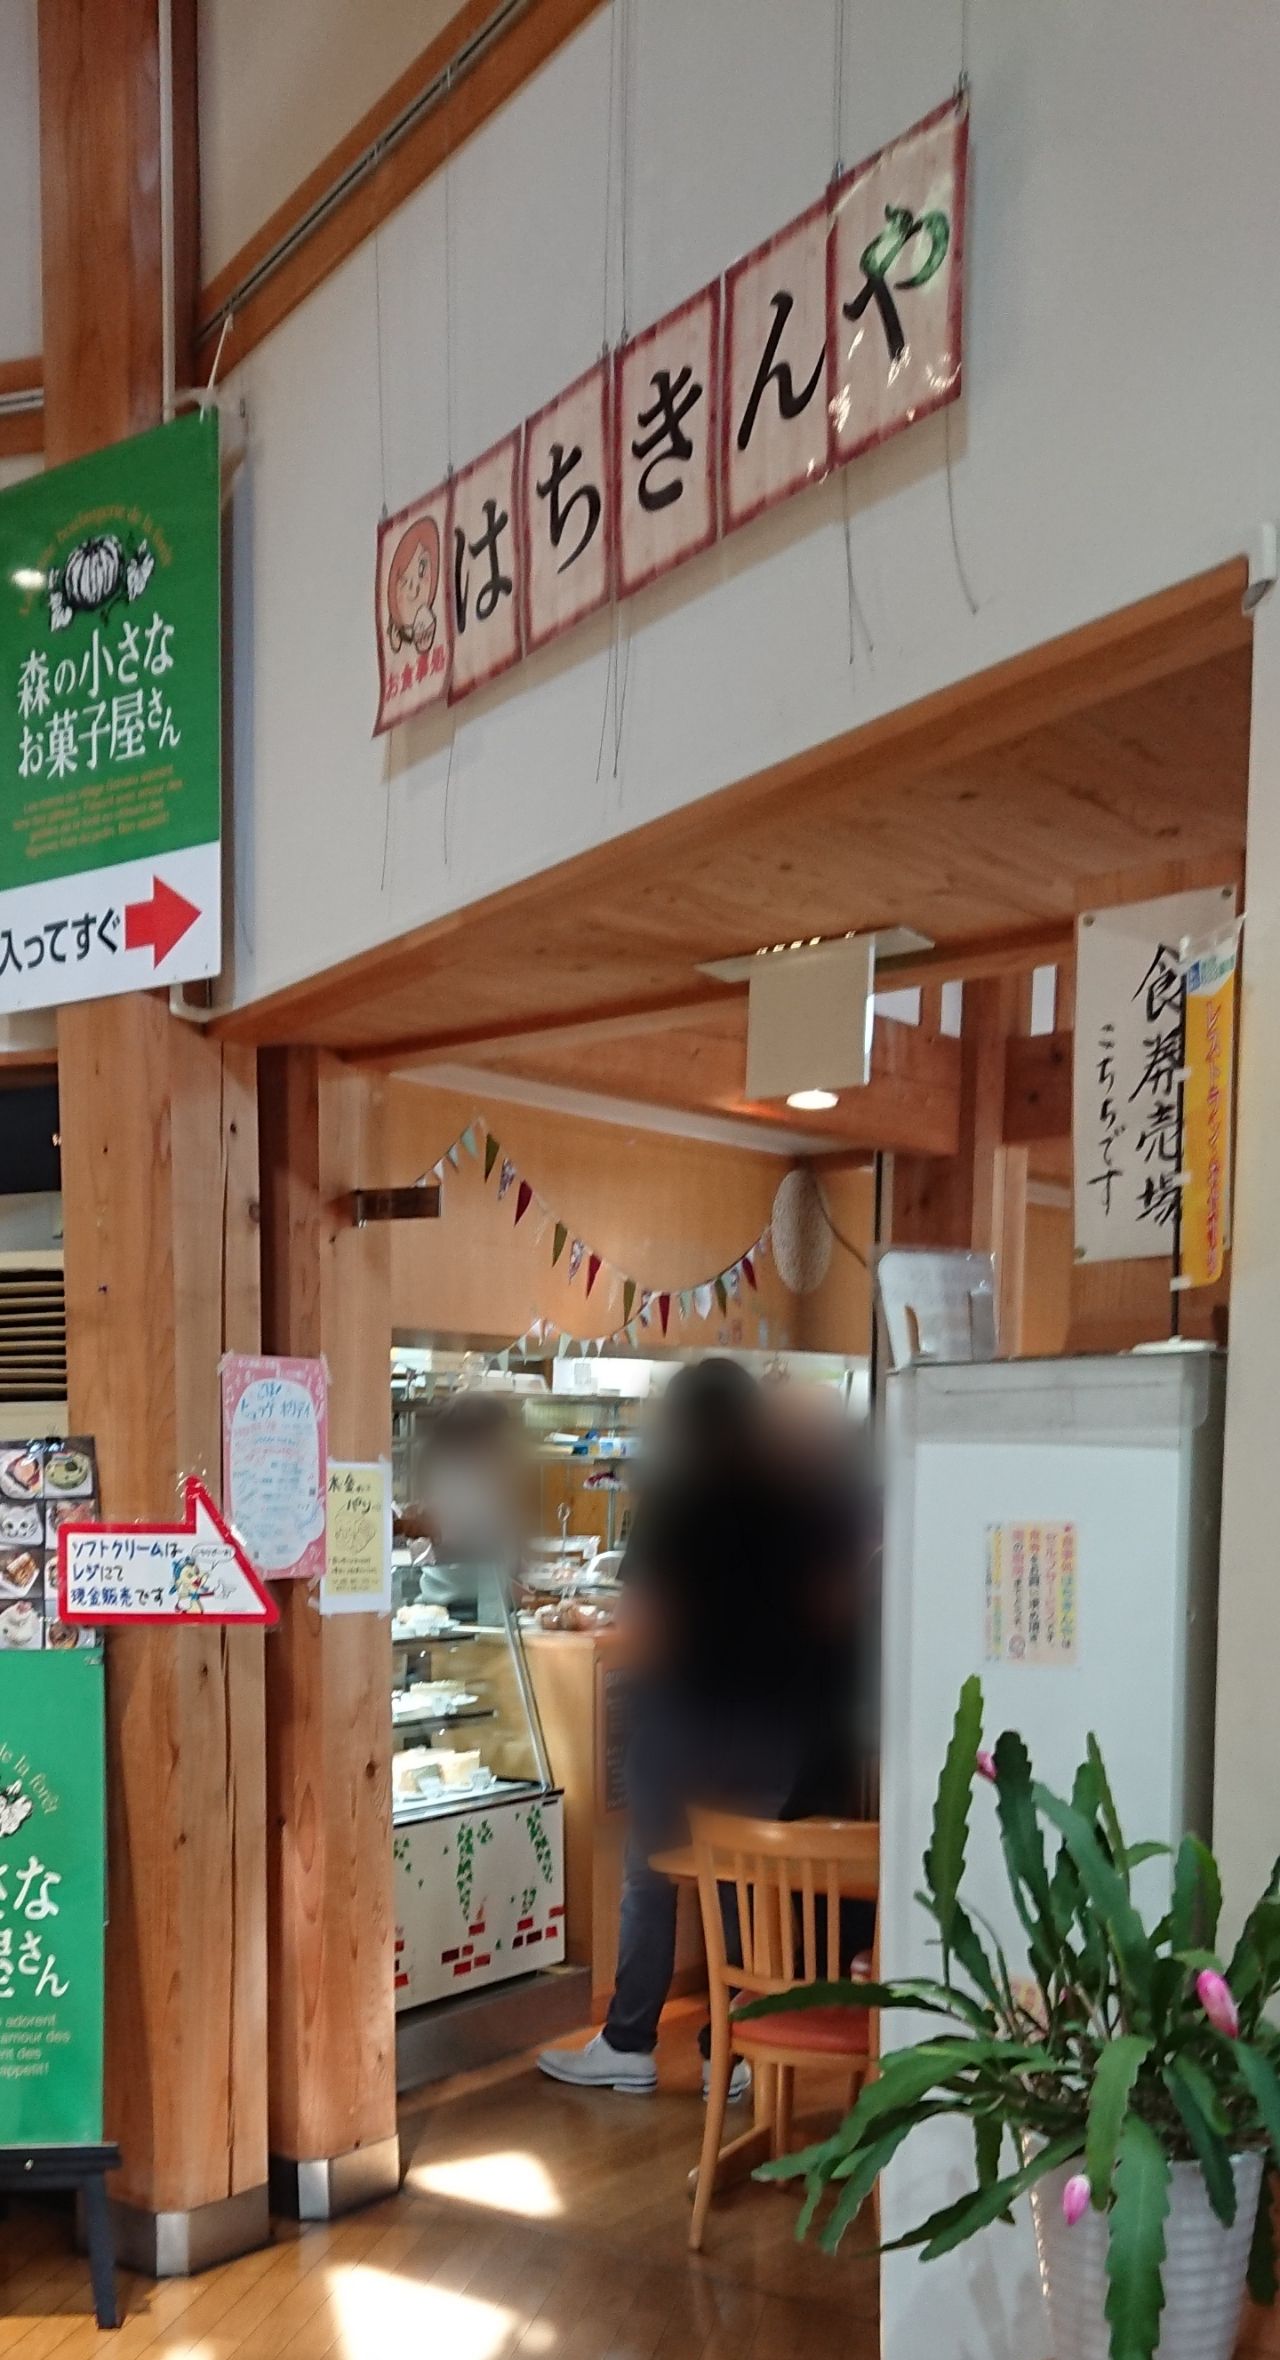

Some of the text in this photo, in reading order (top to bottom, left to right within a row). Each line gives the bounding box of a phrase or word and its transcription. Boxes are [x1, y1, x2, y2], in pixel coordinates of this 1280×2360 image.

[454, 203, 950, 634] はちきんや
[17, 611, 174, 720] 森の小さな
[18, 687, 181, 778] お菓子屋さん
[0, 907, 120, 977] 入ってすぐ
[1087, 1022, 1126, 1217] こちらです
[72, 1539, 184, 1560] ソフトクリームは
[73, 1563, 124, 1582] レジにて
[71, 1585, 164, 1607] 現金販売です
